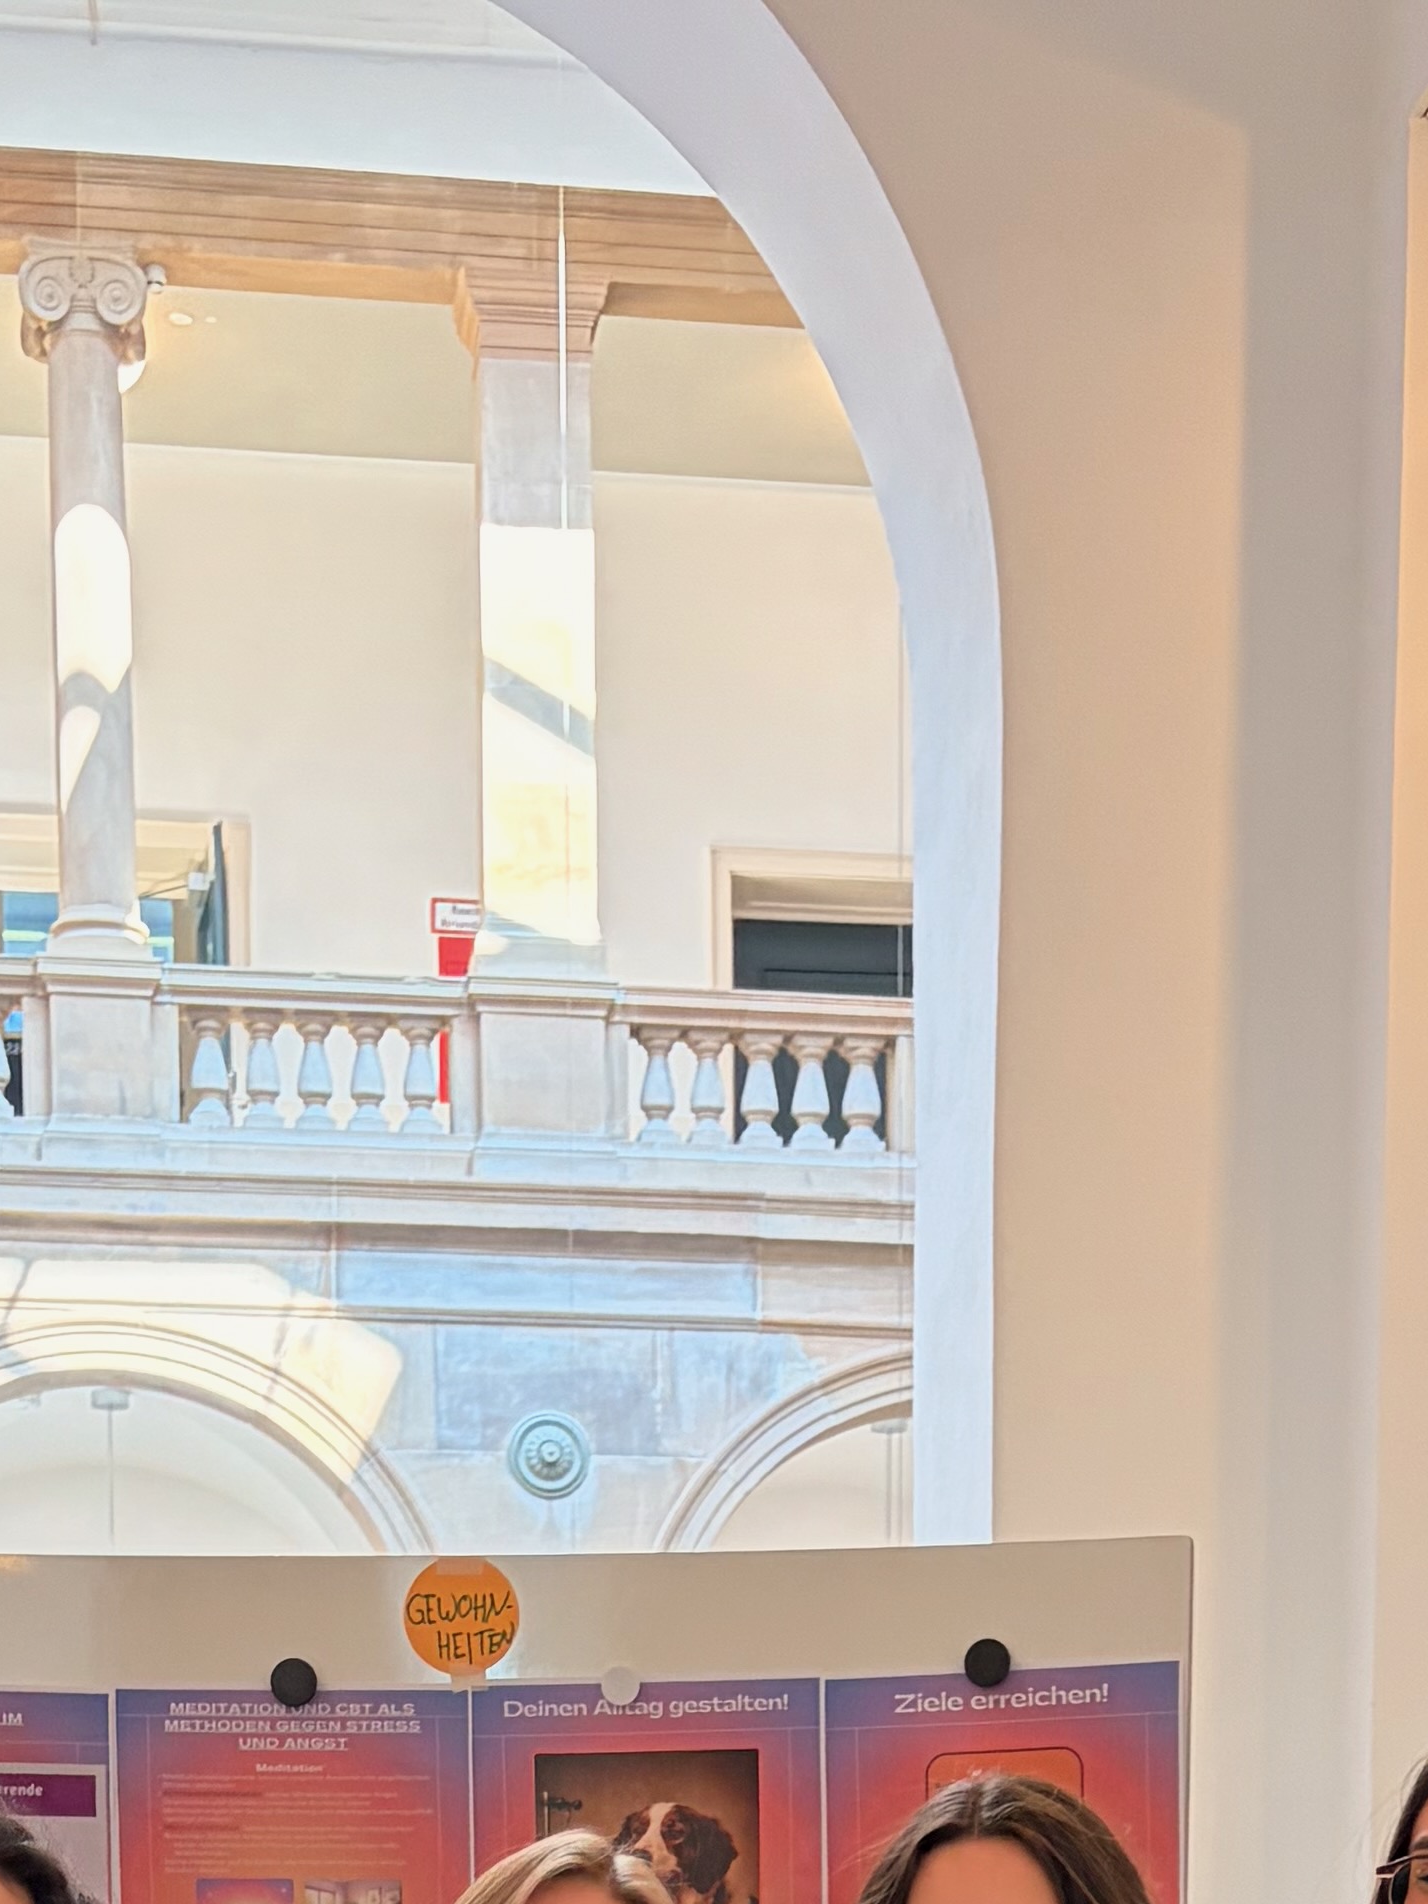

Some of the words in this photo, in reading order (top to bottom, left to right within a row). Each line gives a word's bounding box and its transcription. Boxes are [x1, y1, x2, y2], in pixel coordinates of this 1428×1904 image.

[406, 1590, 513, 1625] GEWOHN-
[437, 1621, 515, 1665] HEITEN
[503, 1701, 587, 1718] Deinen
[669, 1694, 789, 1718] gestalten!
[894, 1691, 963, 1713] Ziele
[971, 1684, 1109, 1710] erreichen!
[3, 1712, 23, 1725] IM
[170, 1702, 286, 1716] MEDITATION
[292, 1703, 331, 1717] UND
[335, 1703, 373, 1717] CBT
[379, 1703, 415, 1717] ALS
[165, 1719, 271, 1733] METHODEN
[276, 1720, 340, 1733] GEGEN
[346, 1720, 421, 1733] STRESS
[238, 1737, 278, 1750] UND
[284, 1737, 348, 1750] ANGST
